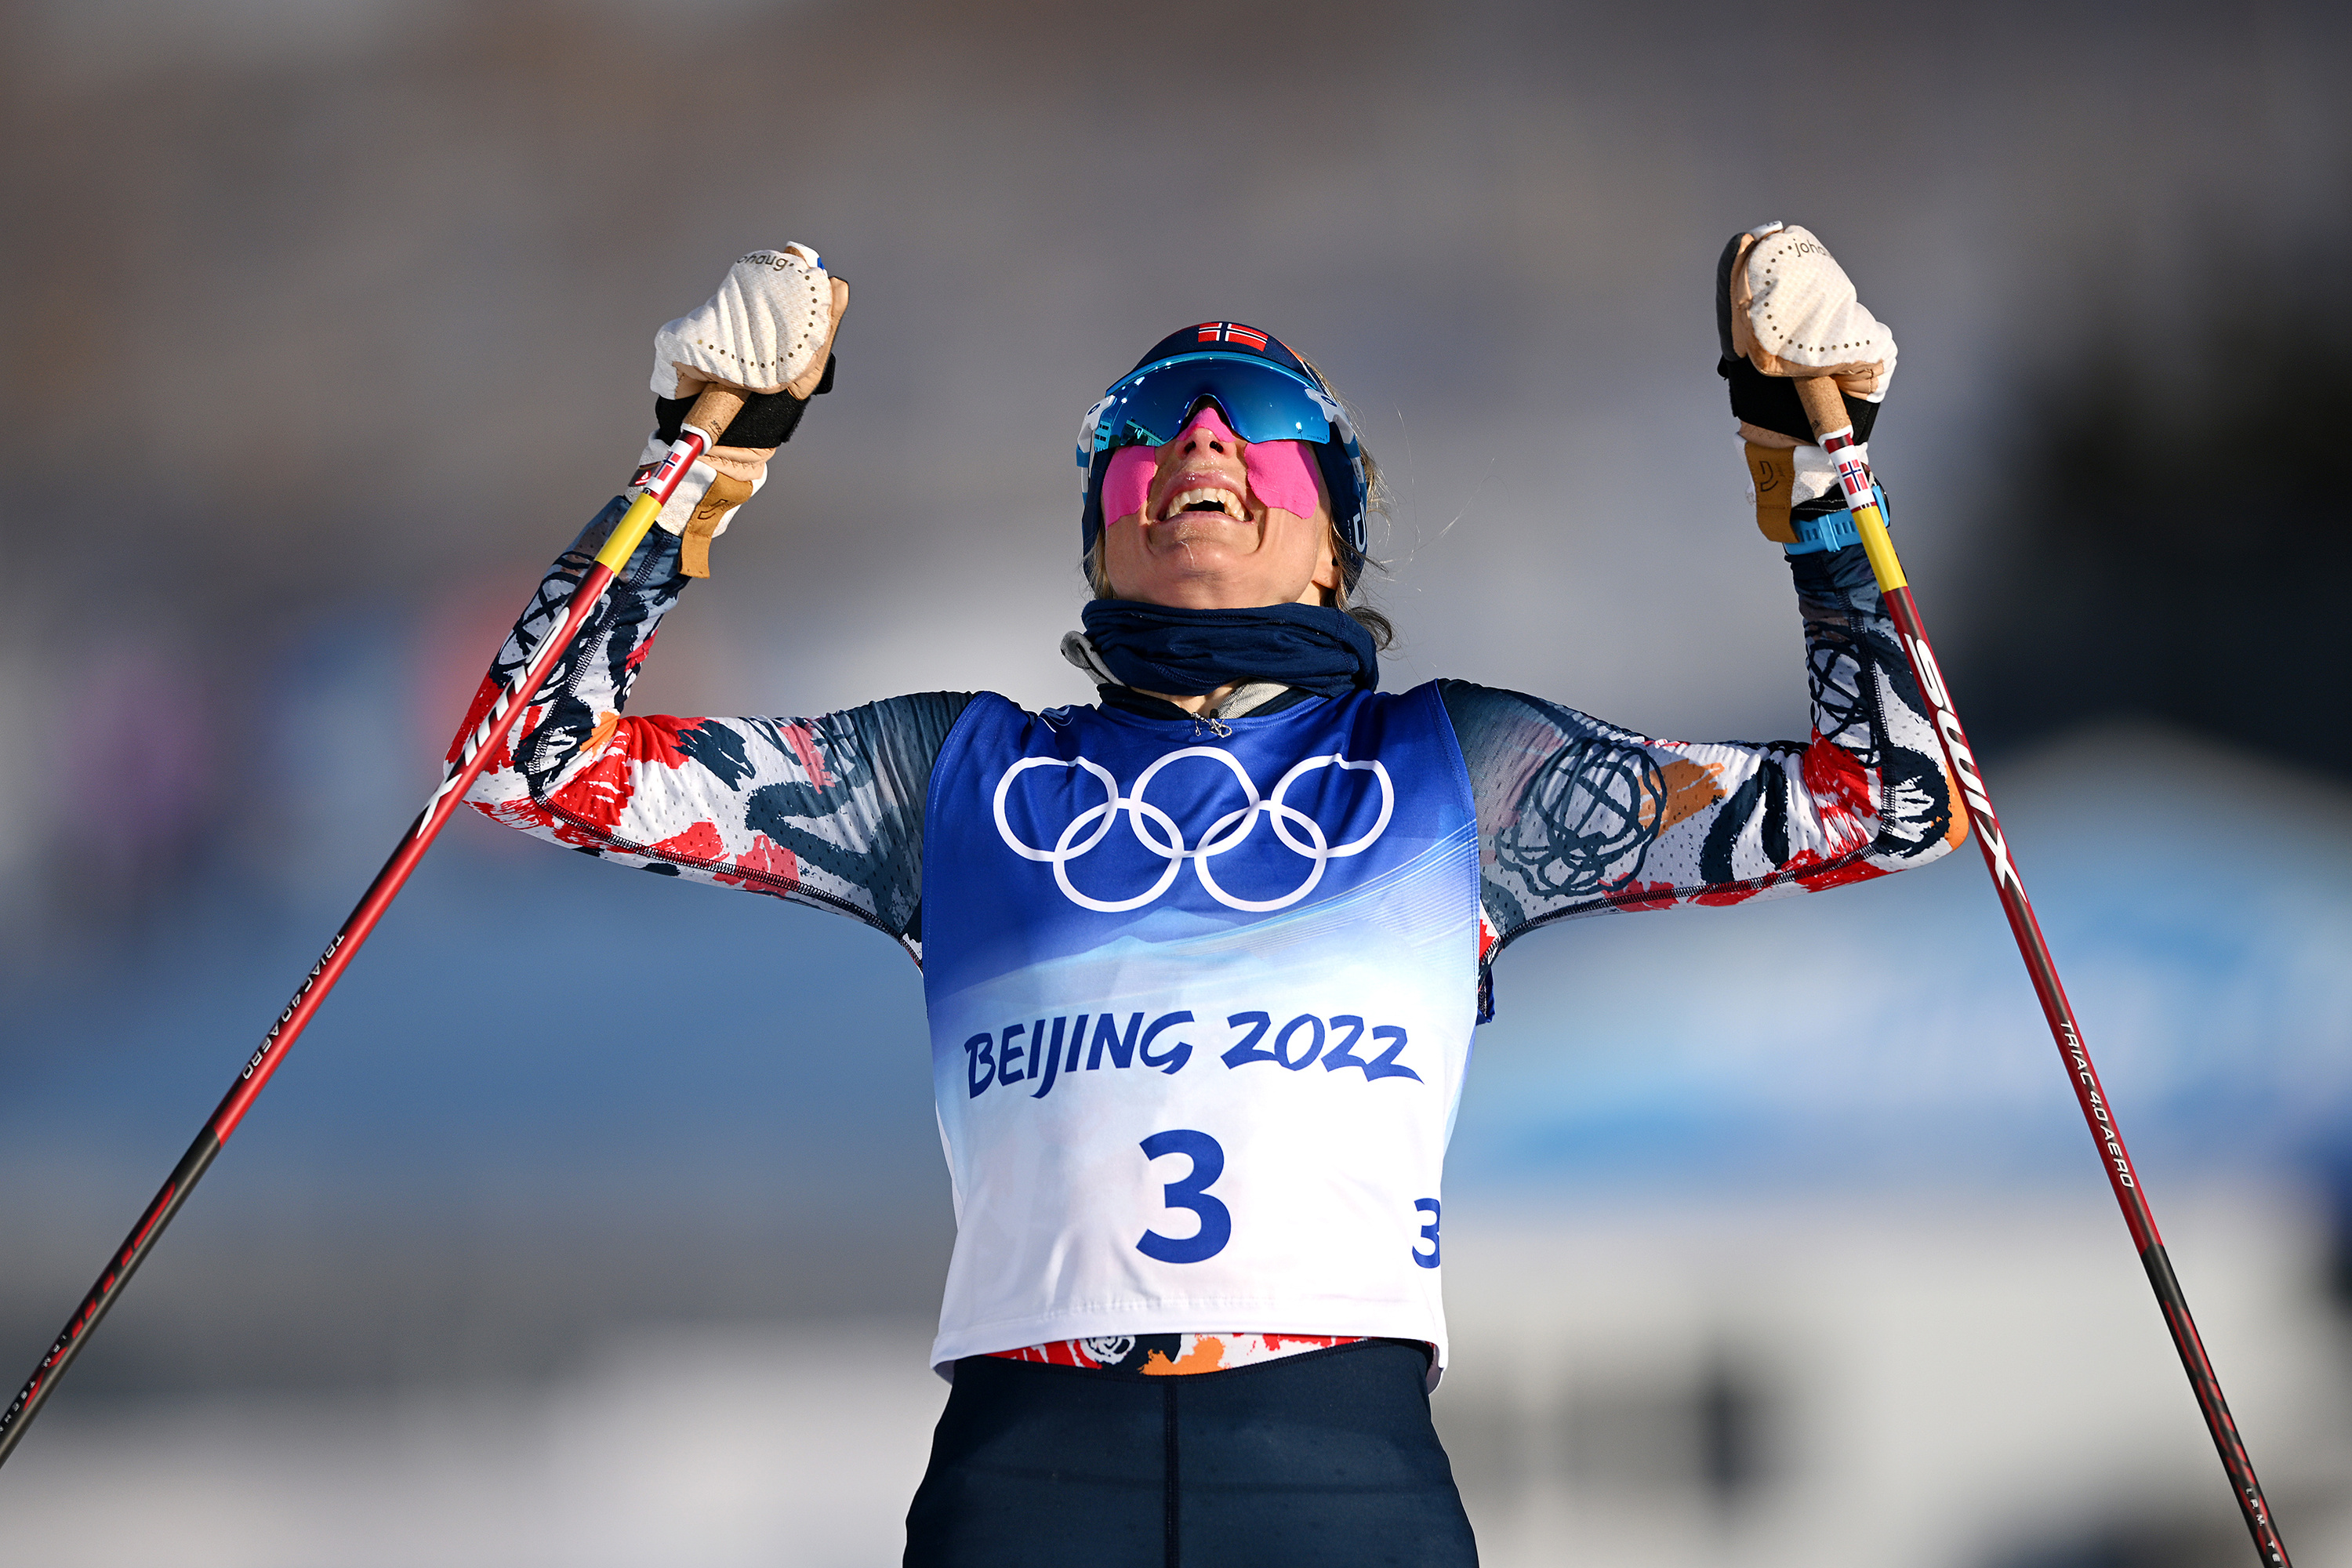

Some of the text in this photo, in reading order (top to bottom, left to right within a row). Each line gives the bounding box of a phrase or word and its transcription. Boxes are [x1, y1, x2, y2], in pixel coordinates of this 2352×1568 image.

[1904, 633, 2028, 903] SWIX
[302, 934, 345, 993] TRIAC
[242, 1021, 281, 1080] AERO
[964, 1010, 1425, 1098] BEIJING 2022
[2060, 1020, 2135, 1189] TRIAC 4.0 AERO
[1135, 1129, 1232, 1265] 3
[1412, 1198, 1441, 1269] 3
